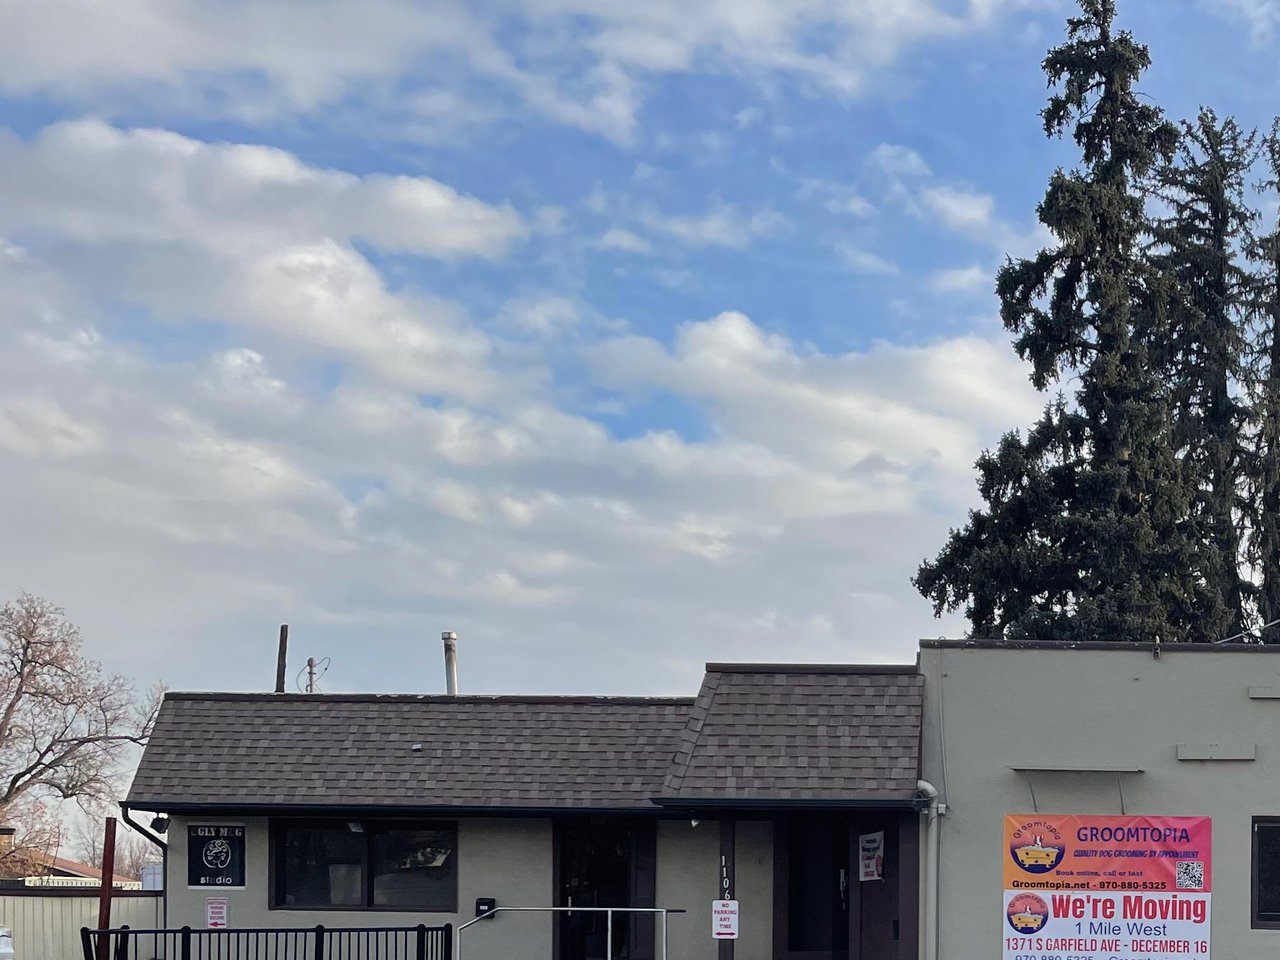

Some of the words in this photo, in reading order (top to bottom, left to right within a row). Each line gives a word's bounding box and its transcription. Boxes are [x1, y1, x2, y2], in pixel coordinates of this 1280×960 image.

[219, 827, 242, 836] MG
[1013, 821, 1061, 840] Groomtopia
[1077, 827, 1190, 843] GROOMTOPIA
[1073, 850, 1098, 858] QUALITY
[1098, 850, 1113, 858] DOG
[1114, 850, 1148, 858] GROOMING
[1148, 850, 1157, 858] BY
[1157, 850, 1199, 859] APPOINTMENT
[200, 876, 232, 884] stdio
[721, 856, 731, 900] 1106
[1012, 880, 1090, 890] Groomtopia.net
[1099, 881, 1167, 890] 970-880-5325
[1009, 894, 1046, 909] Groomtopia
[1051, 895, 1115, 919] We're
[1122, 895, 1206, 924] Moving
[1075, 923, 1082, 935] 1
[1090, 922, 1121, 936] Mile
[1126, 922, 1167, 936] West
[1006, 938, 1033, 951] 1371
[1036, 938, 1043, 951] S
[1046, 938, 1098, 952] GARFIELD
[1100, 940, 1120, 952] AVE
[1131, 940, 1190, 953] DECEMBER
[1194, 941, 1208, 954] 16
